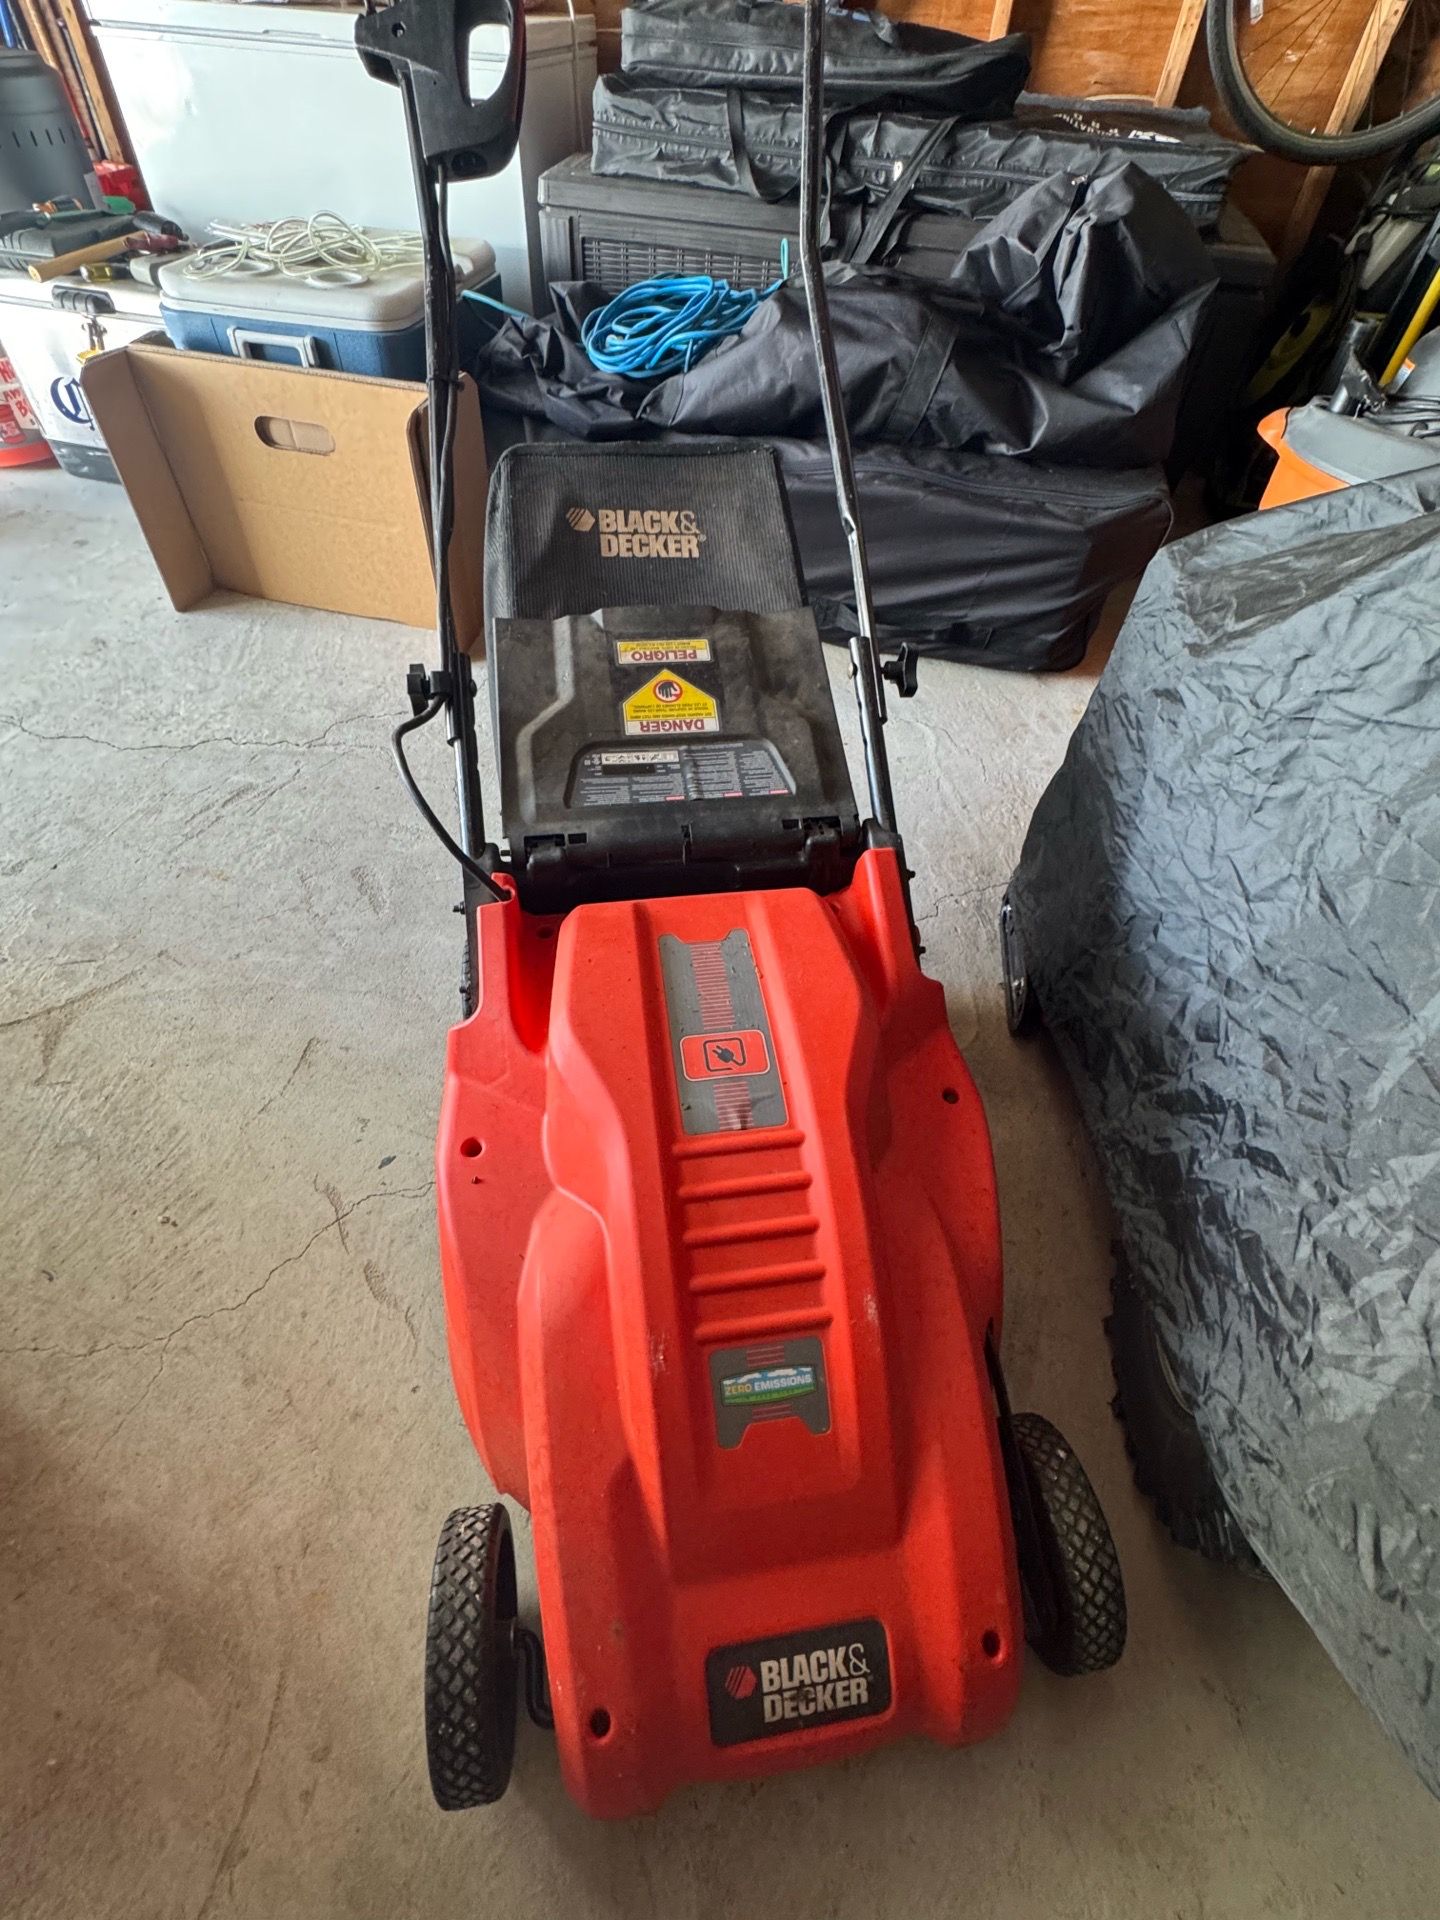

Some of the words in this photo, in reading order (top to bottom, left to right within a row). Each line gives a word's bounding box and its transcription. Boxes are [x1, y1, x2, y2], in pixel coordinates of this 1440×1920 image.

[631, 649, 698, 661] PELIGRO
[639, 718, 705, 733] DANGER
[725, 1383, 752, 1395] ZERO
[754, 1374, 812, 1391] EMISSIONS
